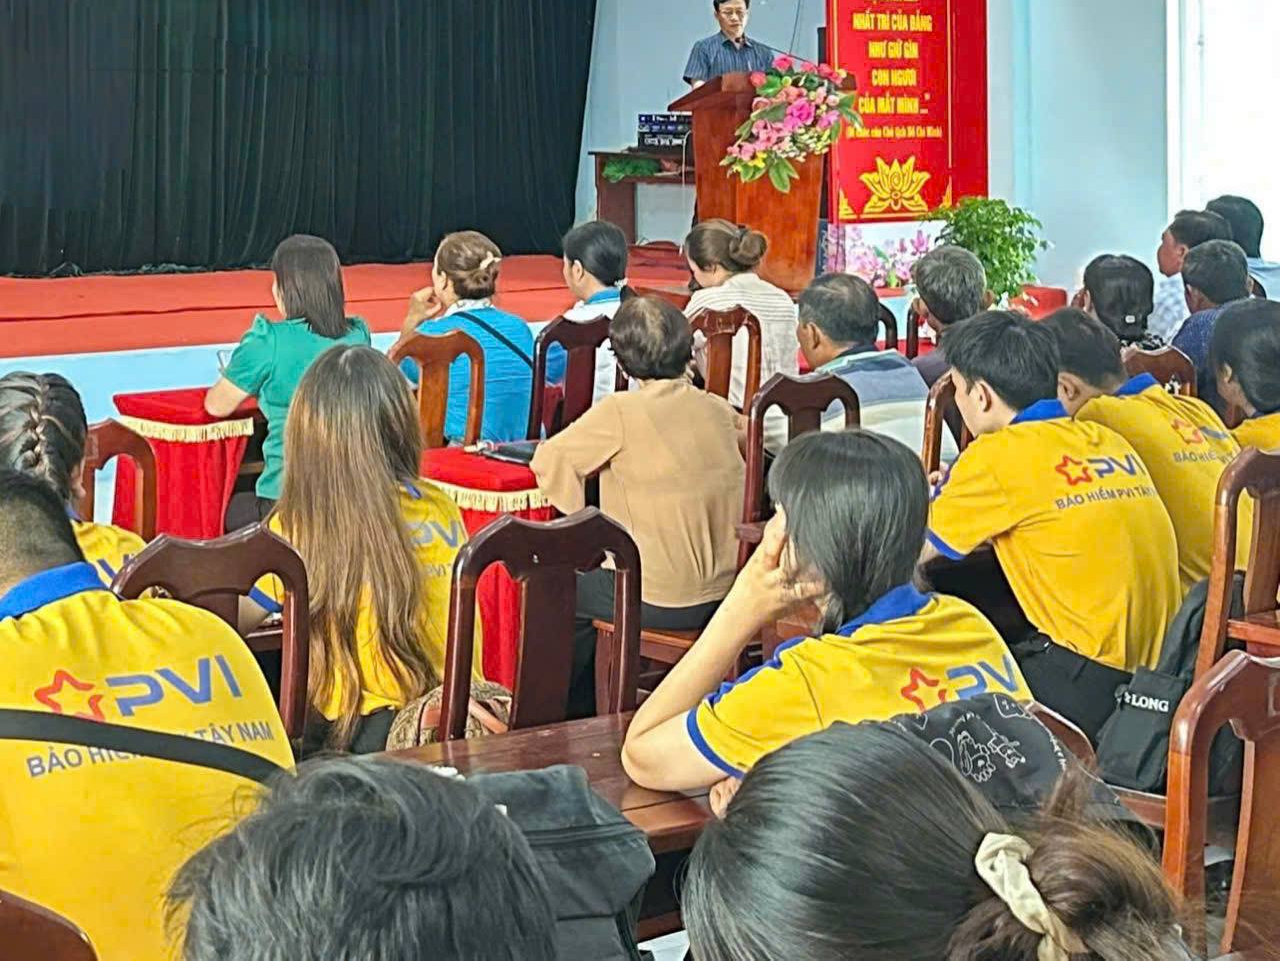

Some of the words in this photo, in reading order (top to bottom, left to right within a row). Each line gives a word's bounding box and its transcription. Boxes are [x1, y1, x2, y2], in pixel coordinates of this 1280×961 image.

[891, 8, 909, 32] CỦA
[871, 68, 890, 87] CON
[858, 91, 876, 115] CỦA
[1086, 453, 1146, 478] PVI
[1056, 492, 1085, 509] BẢO
[1086, 485, 1117, 503] HIỂM
[106, 653, 243, 717] PVI
[26, 745, 82, 777] BẢO
[236, 720, 275, 742] NAM
